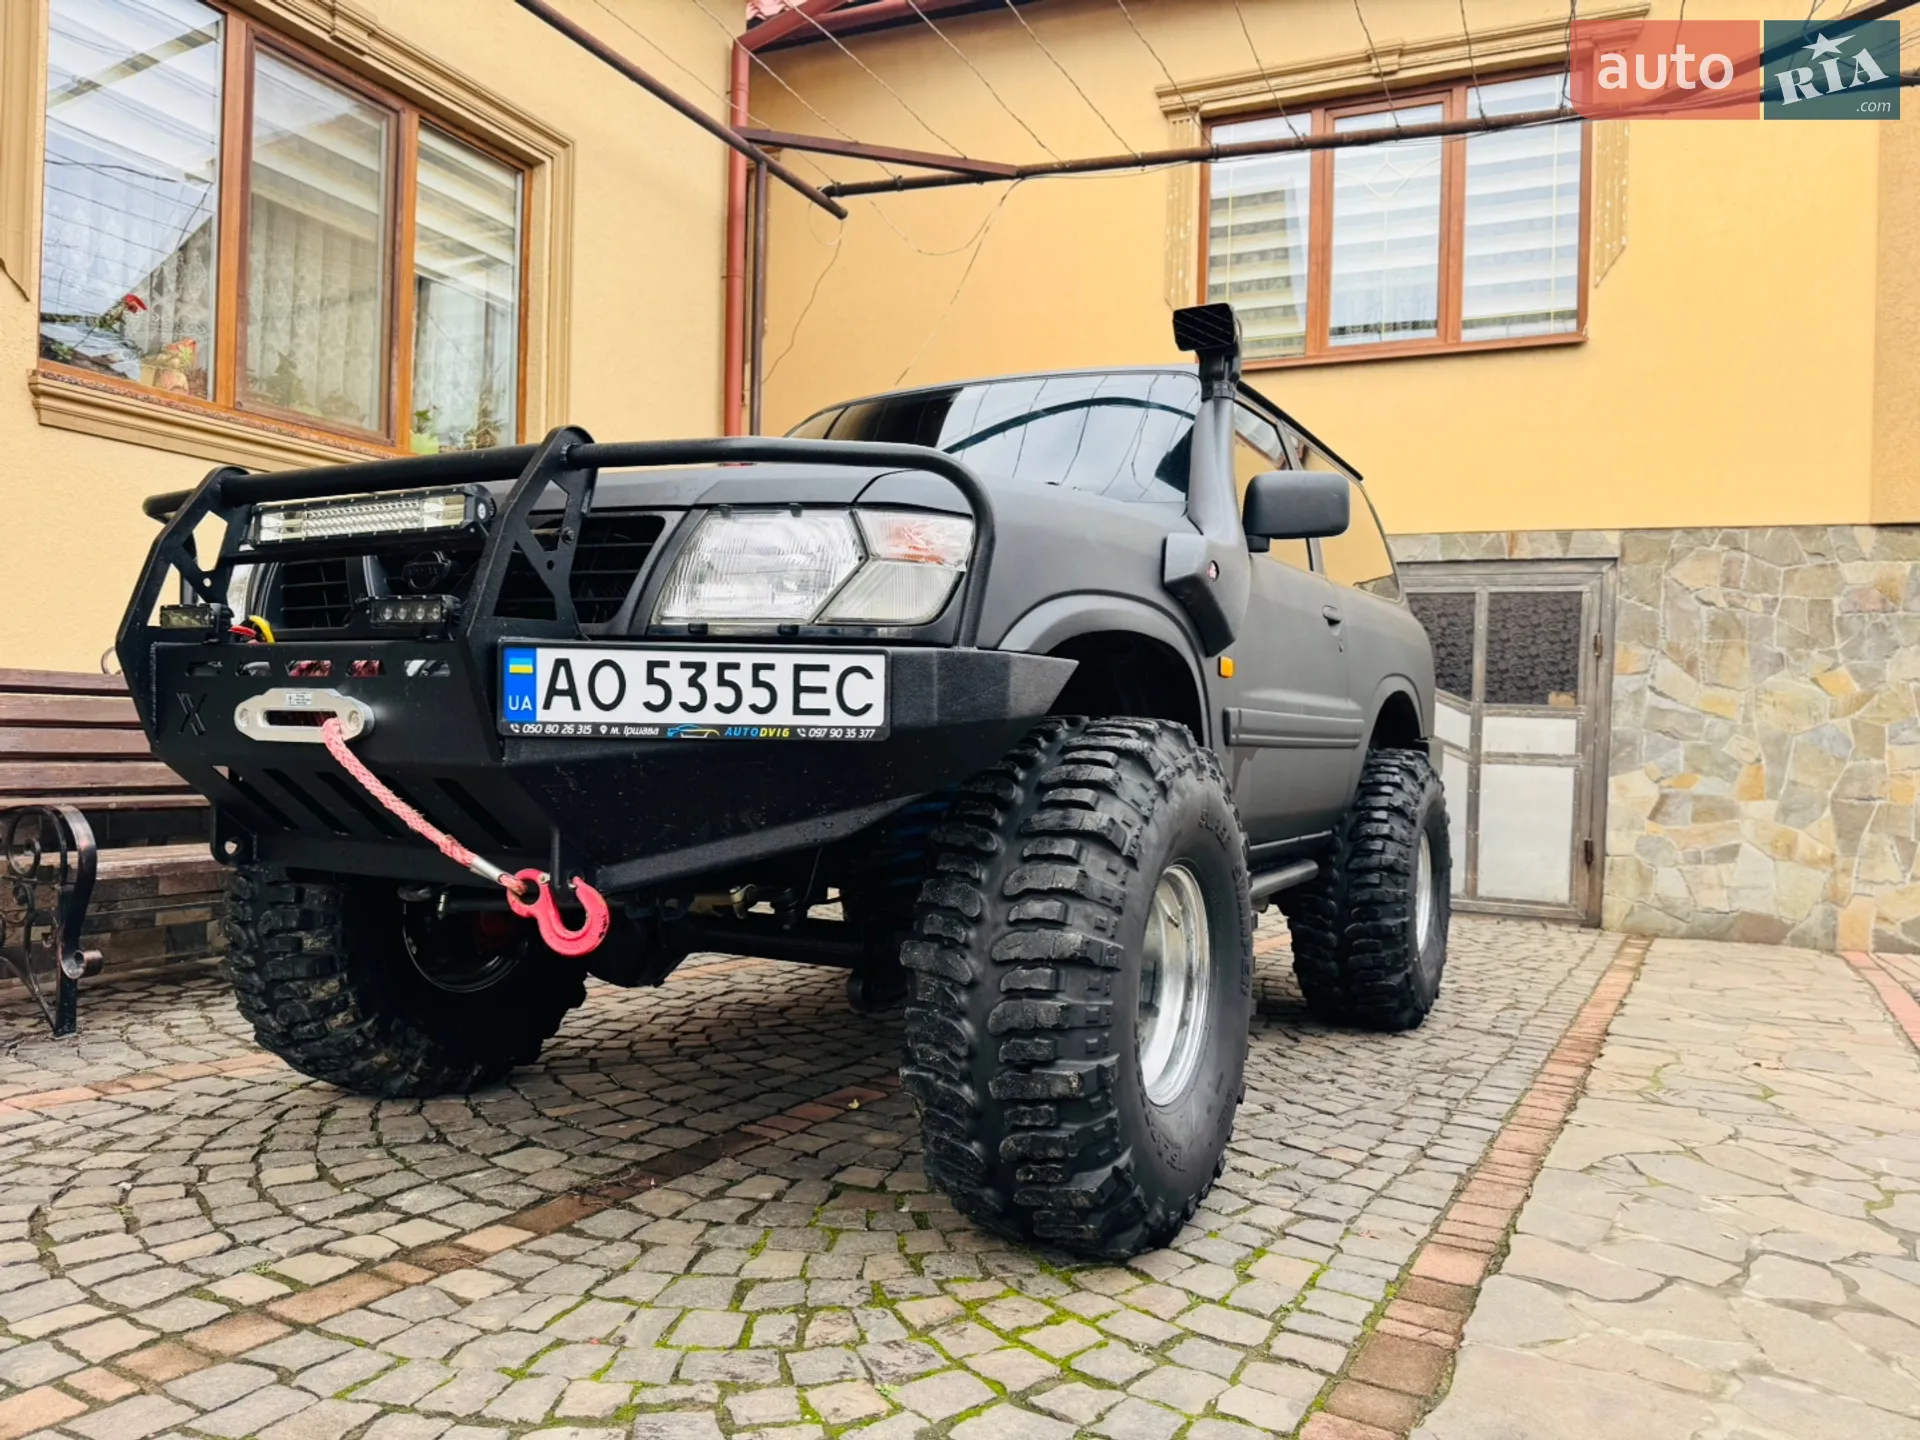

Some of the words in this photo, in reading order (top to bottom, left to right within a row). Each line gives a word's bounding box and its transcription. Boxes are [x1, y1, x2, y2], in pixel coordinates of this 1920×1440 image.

[542, 657, 627, 712] AO
[642, 660, 778, 715] 5355
[792, 663, 874, 717] EC
[508, 695, 533, 712] UA
[522, 724, 543, 734] 050
[545, 724, 557, 734] 80
[561, 724, 574, 735] 26
[576, 724, 592, 735] 315
[808, 728, 828, 738] 097
[830, 728, 843, 739] 90
[844, 728, 857, 739] 35
[858, 728, 876, 739] 377
